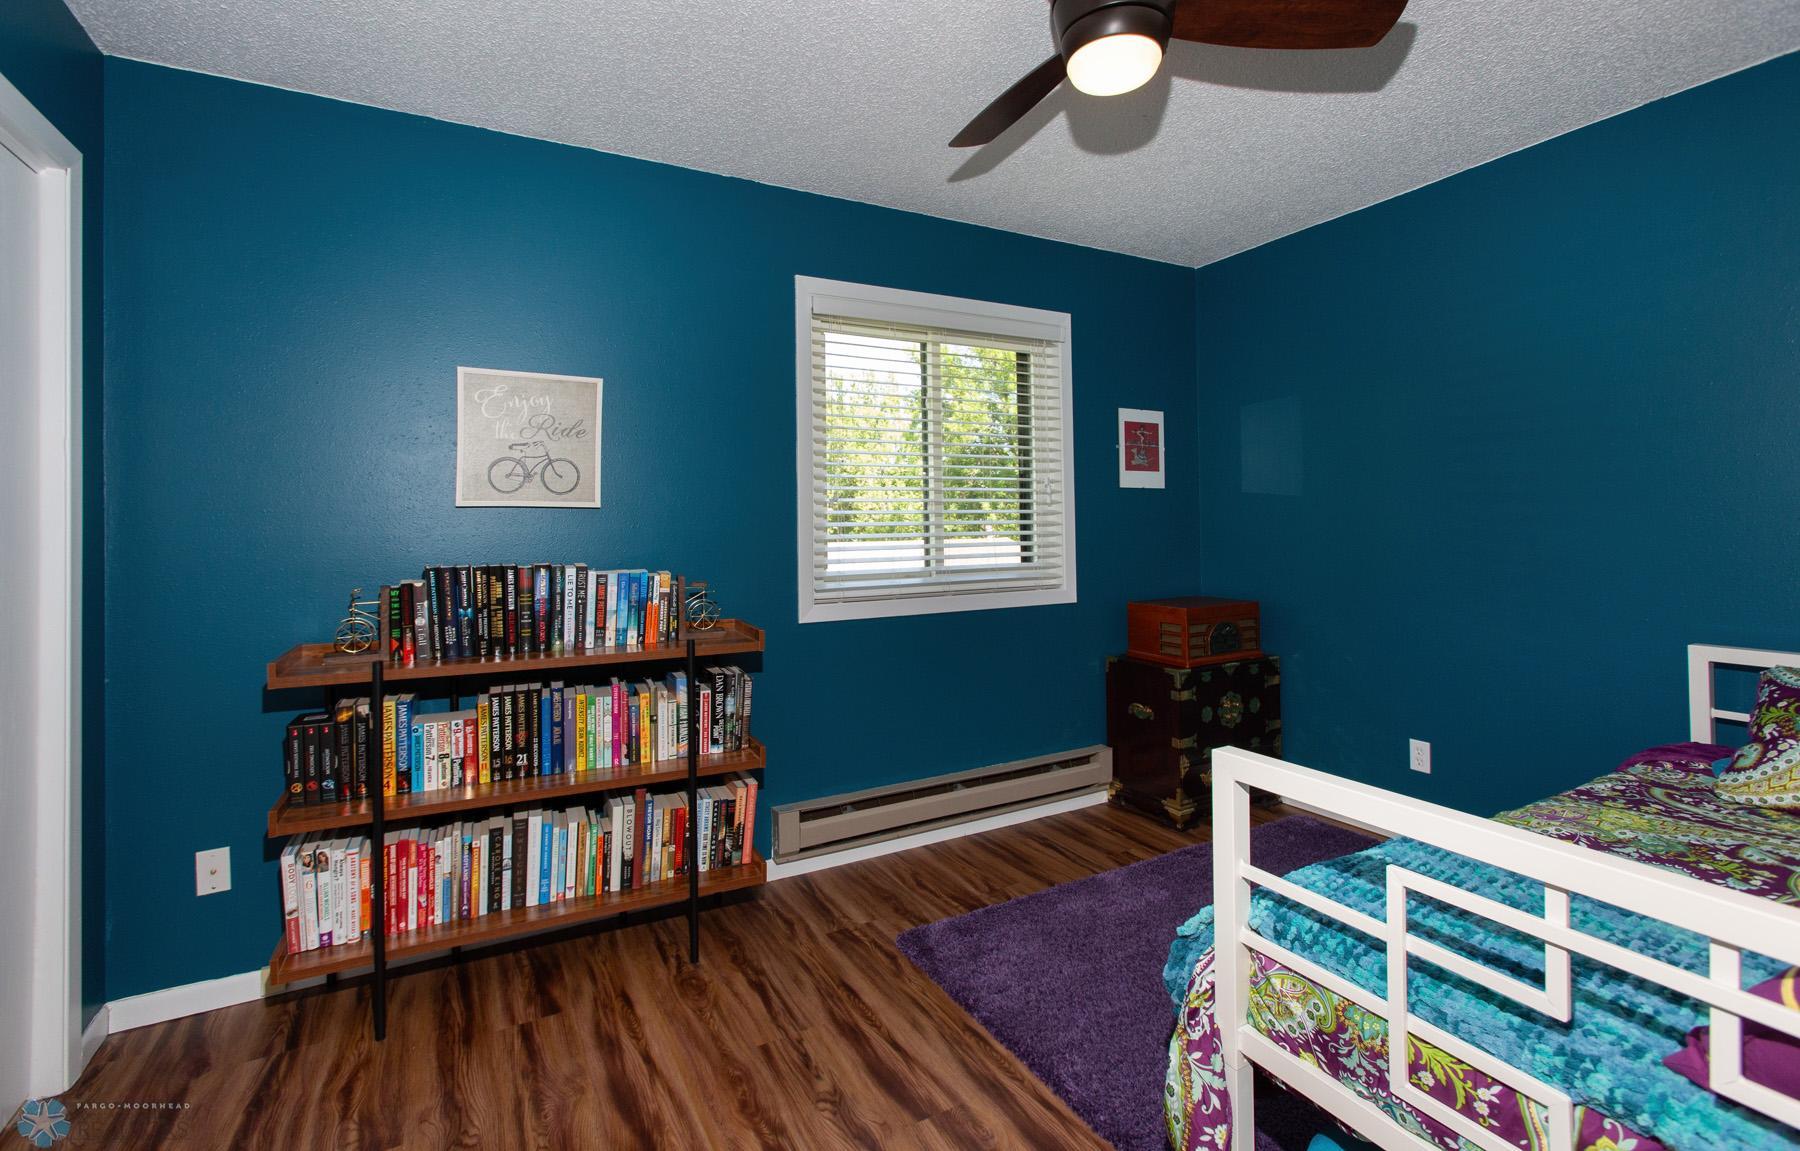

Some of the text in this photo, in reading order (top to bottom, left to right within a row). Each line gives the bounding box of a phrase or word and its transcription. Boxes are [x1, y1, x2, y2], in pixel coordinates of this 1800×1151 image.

[474, 384, 553, 424] Enjoy
[519, 413, 588, 441] Ride
[507, 569, 515, 584] JAMES
[577, 571, 586, 599] TRUST ME
[567, 588, 574, 598] TO
[567, 599, 573, 610] ME
[715, 675, 724, 719] DAN BROWN
[383, 705, 393, 731] JAMES
[480, 705, 488, 726] JAMES
[491, 697, 500, 752] JAMES PATTERSON
[504, 696, 513, 750] JAMES PATTERSON
[517, 694, 526, 748] JAMES PATTERSON
[358, 723, 367, 781] JAMES PATTERSON
[397, 704, 408, 771] JAMES PATTERSON
[425, 725, 435, 755] Patterson
[438, 724, 449, 752] Patterson
[481, 726, 489, 761] PATTERSON
[383, 731, 393, 779] PATTERSON
[516, 753, 528, 766] 21
[625, 809, 633, 851] BLOWOUT
[288, 863, 296, 884] BODY
[494, 836, 502, 899] CAROLE KING
